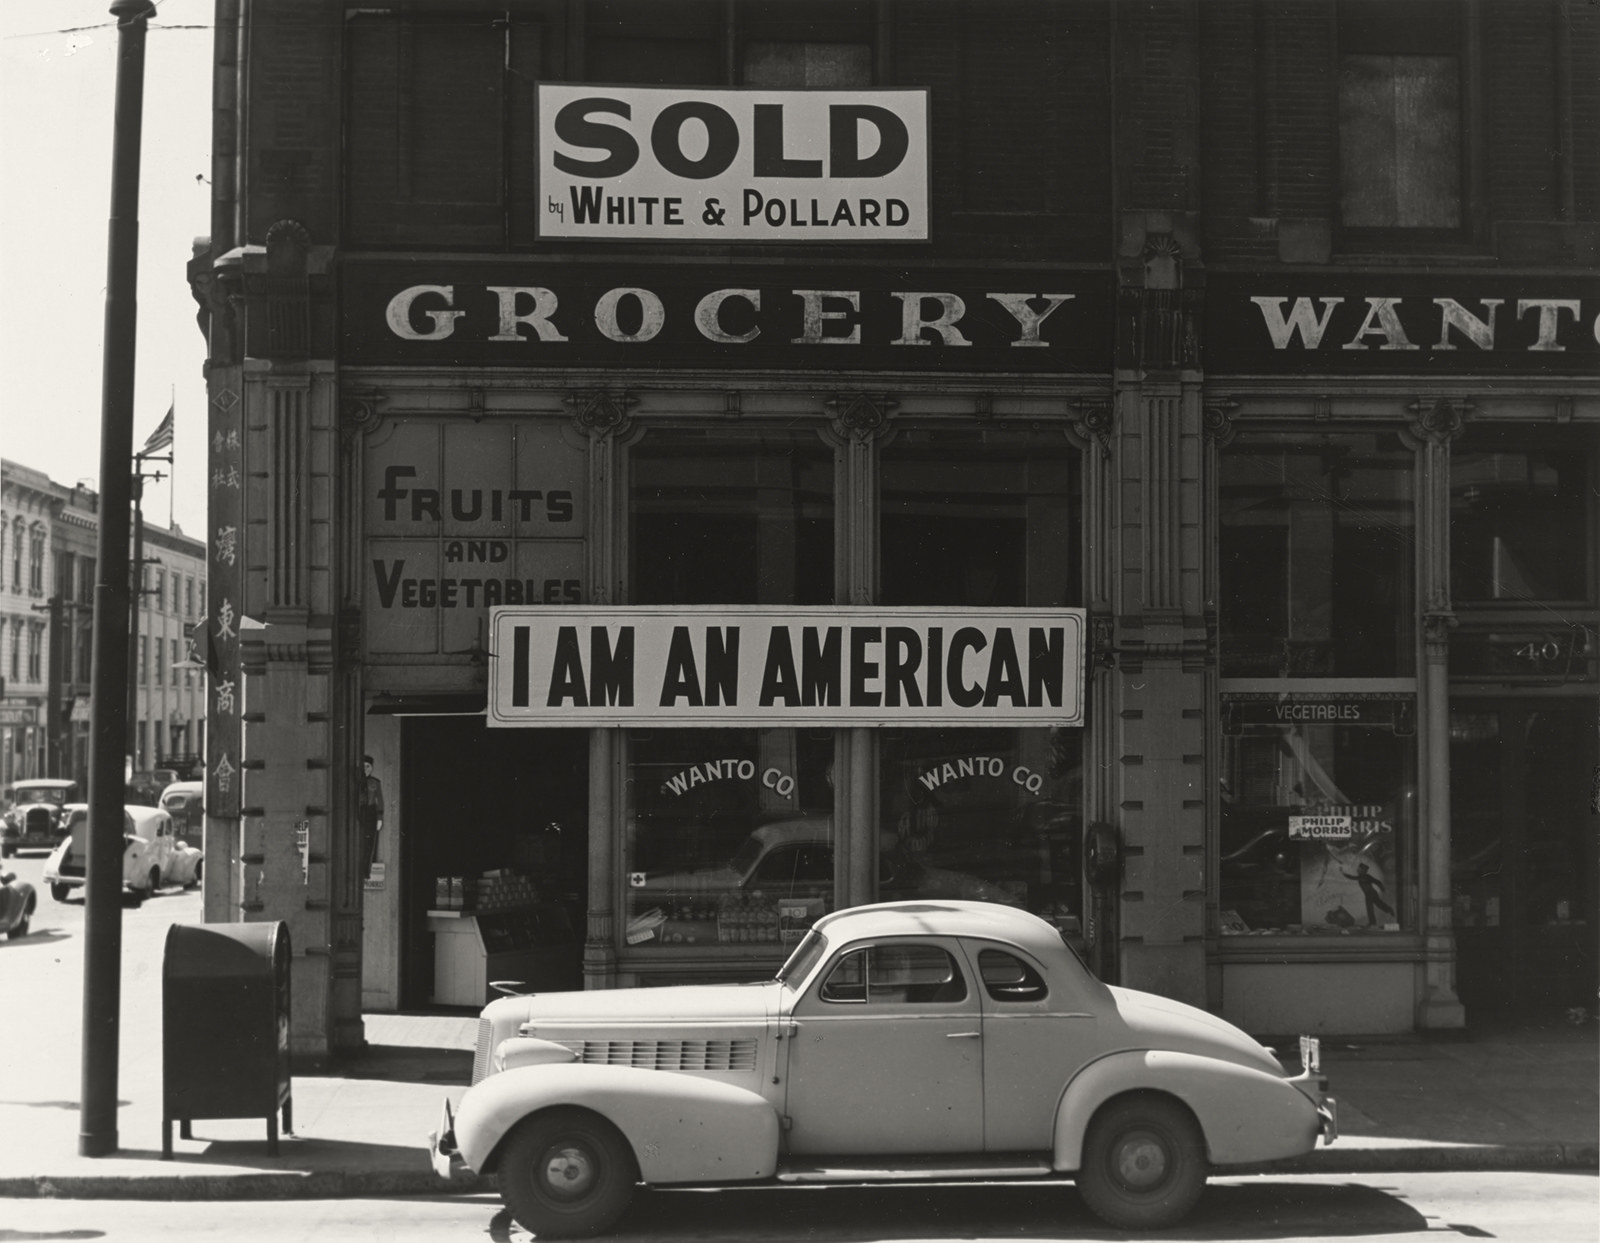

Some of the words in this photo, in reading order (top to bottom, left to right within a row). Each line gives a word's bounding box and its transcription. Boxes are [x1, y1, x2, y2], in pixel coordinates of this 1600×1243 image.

[553, 97, 910, 180] SOLD
[548, 194, 564, 223] by
[569, 185, 684, 225] WHITE
[702, 198, 726, 226] &
[743, 188, 910, 227] POLLARD
[385, 284, 1076, 348] GROCERY
[1250, 296, 1600, 351] WANT
[445, 541, 508, 562] AND
[373, 559, 581, 608] VEGETABLES
[512, 626, 531, 707] I
[546, 626, 635, 707] AM
[659, 626, 740, 707] AN
[758, 626, 1065, 708] AMERICAN
[1275, 704, 1360, 720] VEGETABLES
[665, 758, 755, 796] WANTO
[762, 767, 795, 800] CO.
[918, 756, 1004, 791] WANTO
[1012, 765, 1043, 796] CO.
[1301, 826, 1351, 835] MORRIS
[1302, 818, 1345, 826] PHILIP
